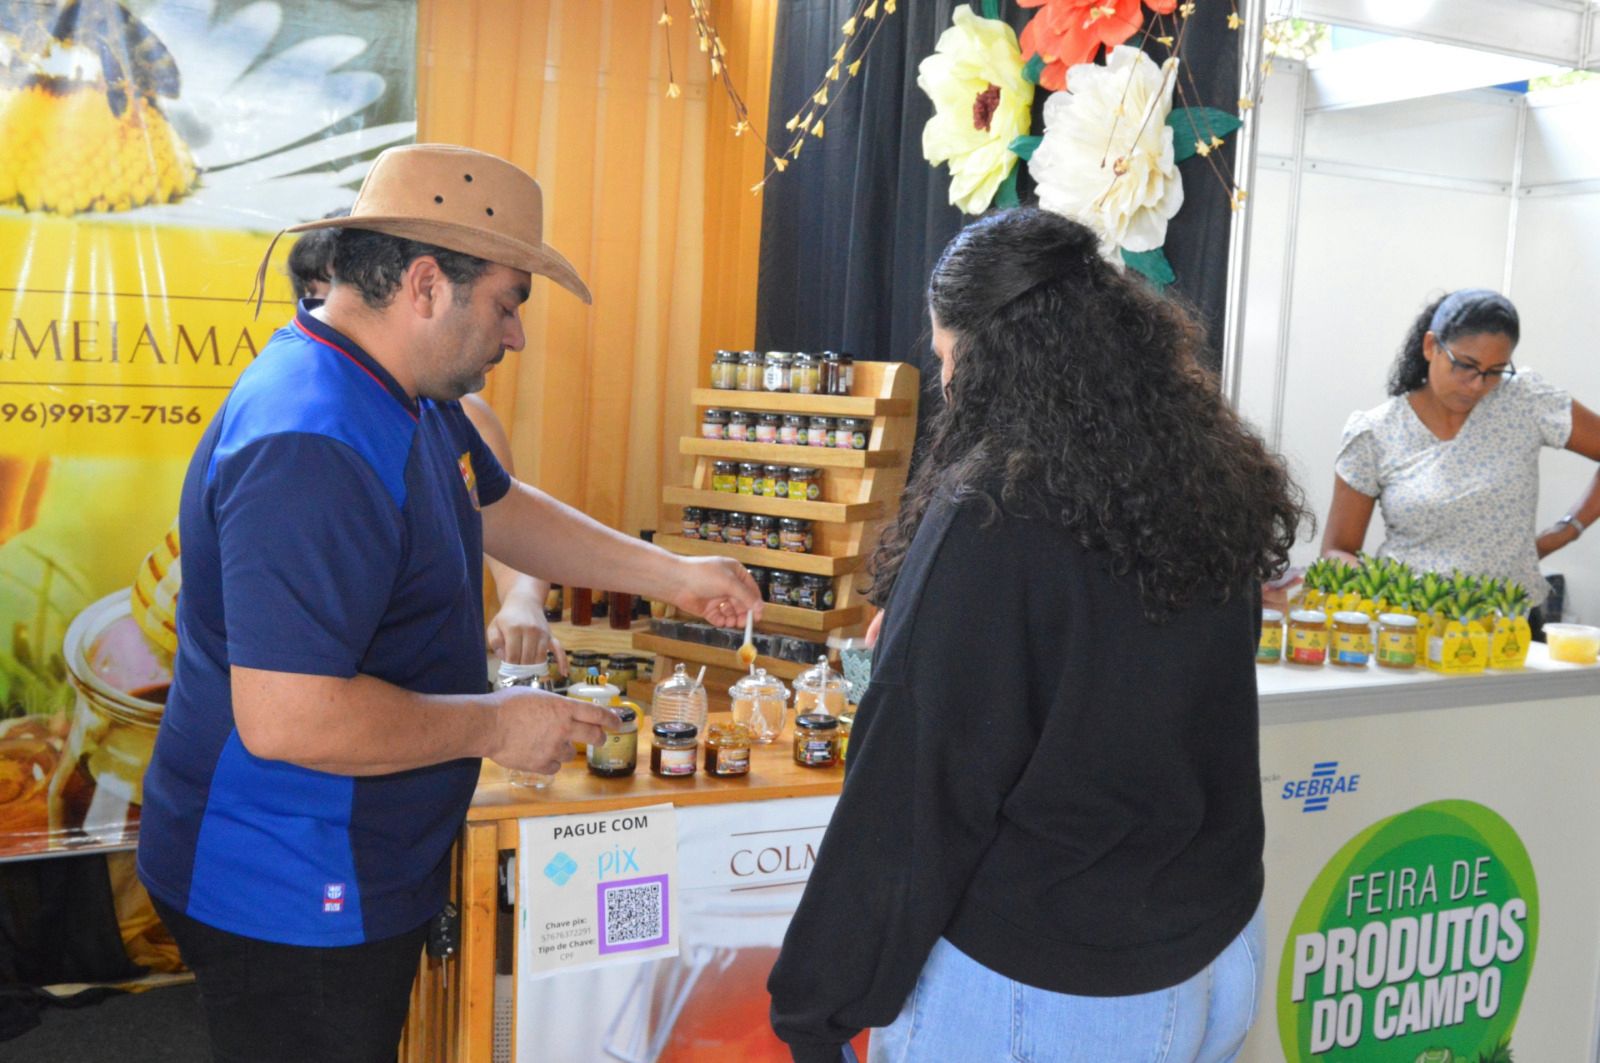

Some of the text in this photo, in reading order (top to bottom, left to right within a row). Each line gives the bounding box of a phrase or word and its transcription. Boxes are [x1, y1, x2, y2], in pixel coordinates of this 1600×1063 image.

[0, 318, 262, 366] MEIAMA
[1281, 774, 1360, 800] SEBRAE
[553, 815, 648, 840] PAGUE COM
[597, 844, 640, 880] pix
[1346, 856, 1491, 917] FEIRA DE
[545, 919, 571, 930] Chave
[538, 944, 556, 954] Tipo
[557, 942, 568, 951] de
[560, 952, 574, 961] CPF
[1291, 898, 1527, 1003] PRODUTOS
[1310, 966, 1501, 1055] DO CAMPO
